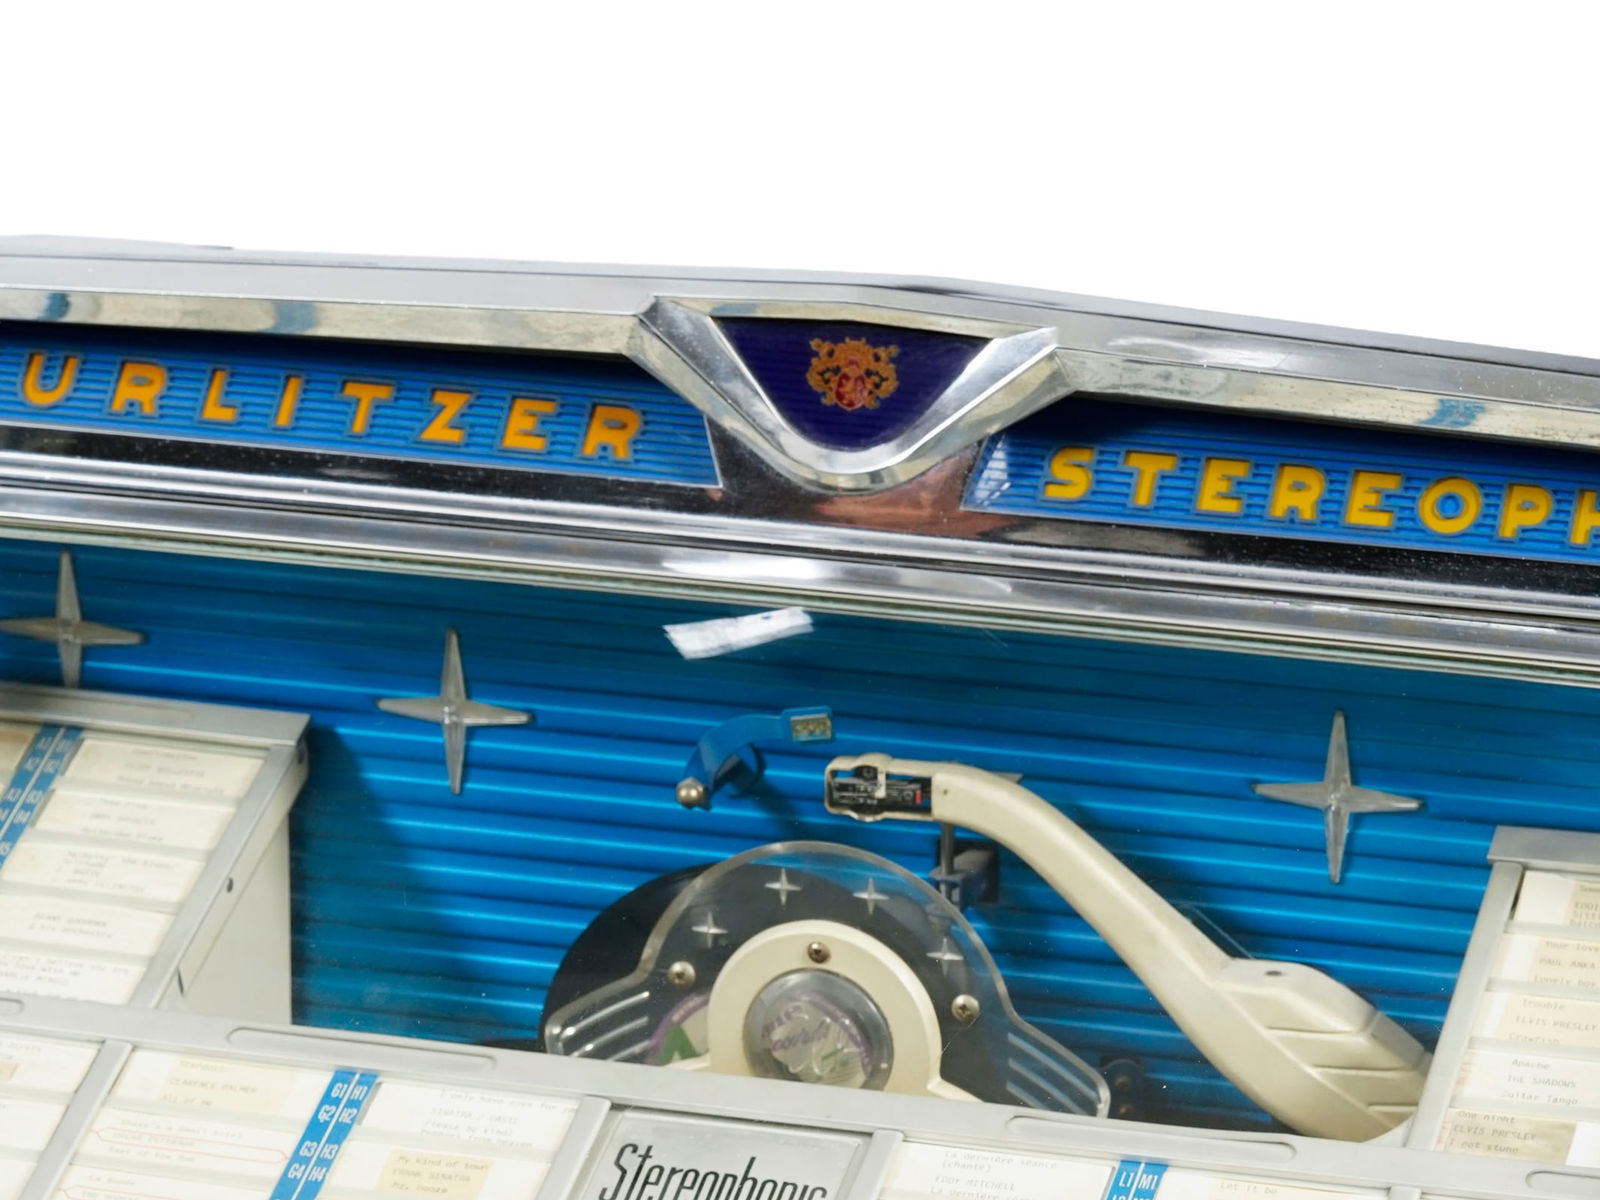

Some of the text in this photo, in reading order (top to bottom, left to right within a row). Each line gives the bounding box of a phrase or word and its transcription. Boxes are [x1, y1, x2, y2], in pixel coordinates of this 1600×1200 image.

[331, 1082, 366, 1100] G1 H1
[1119, 1171, 1158, 1190] L1 M1
